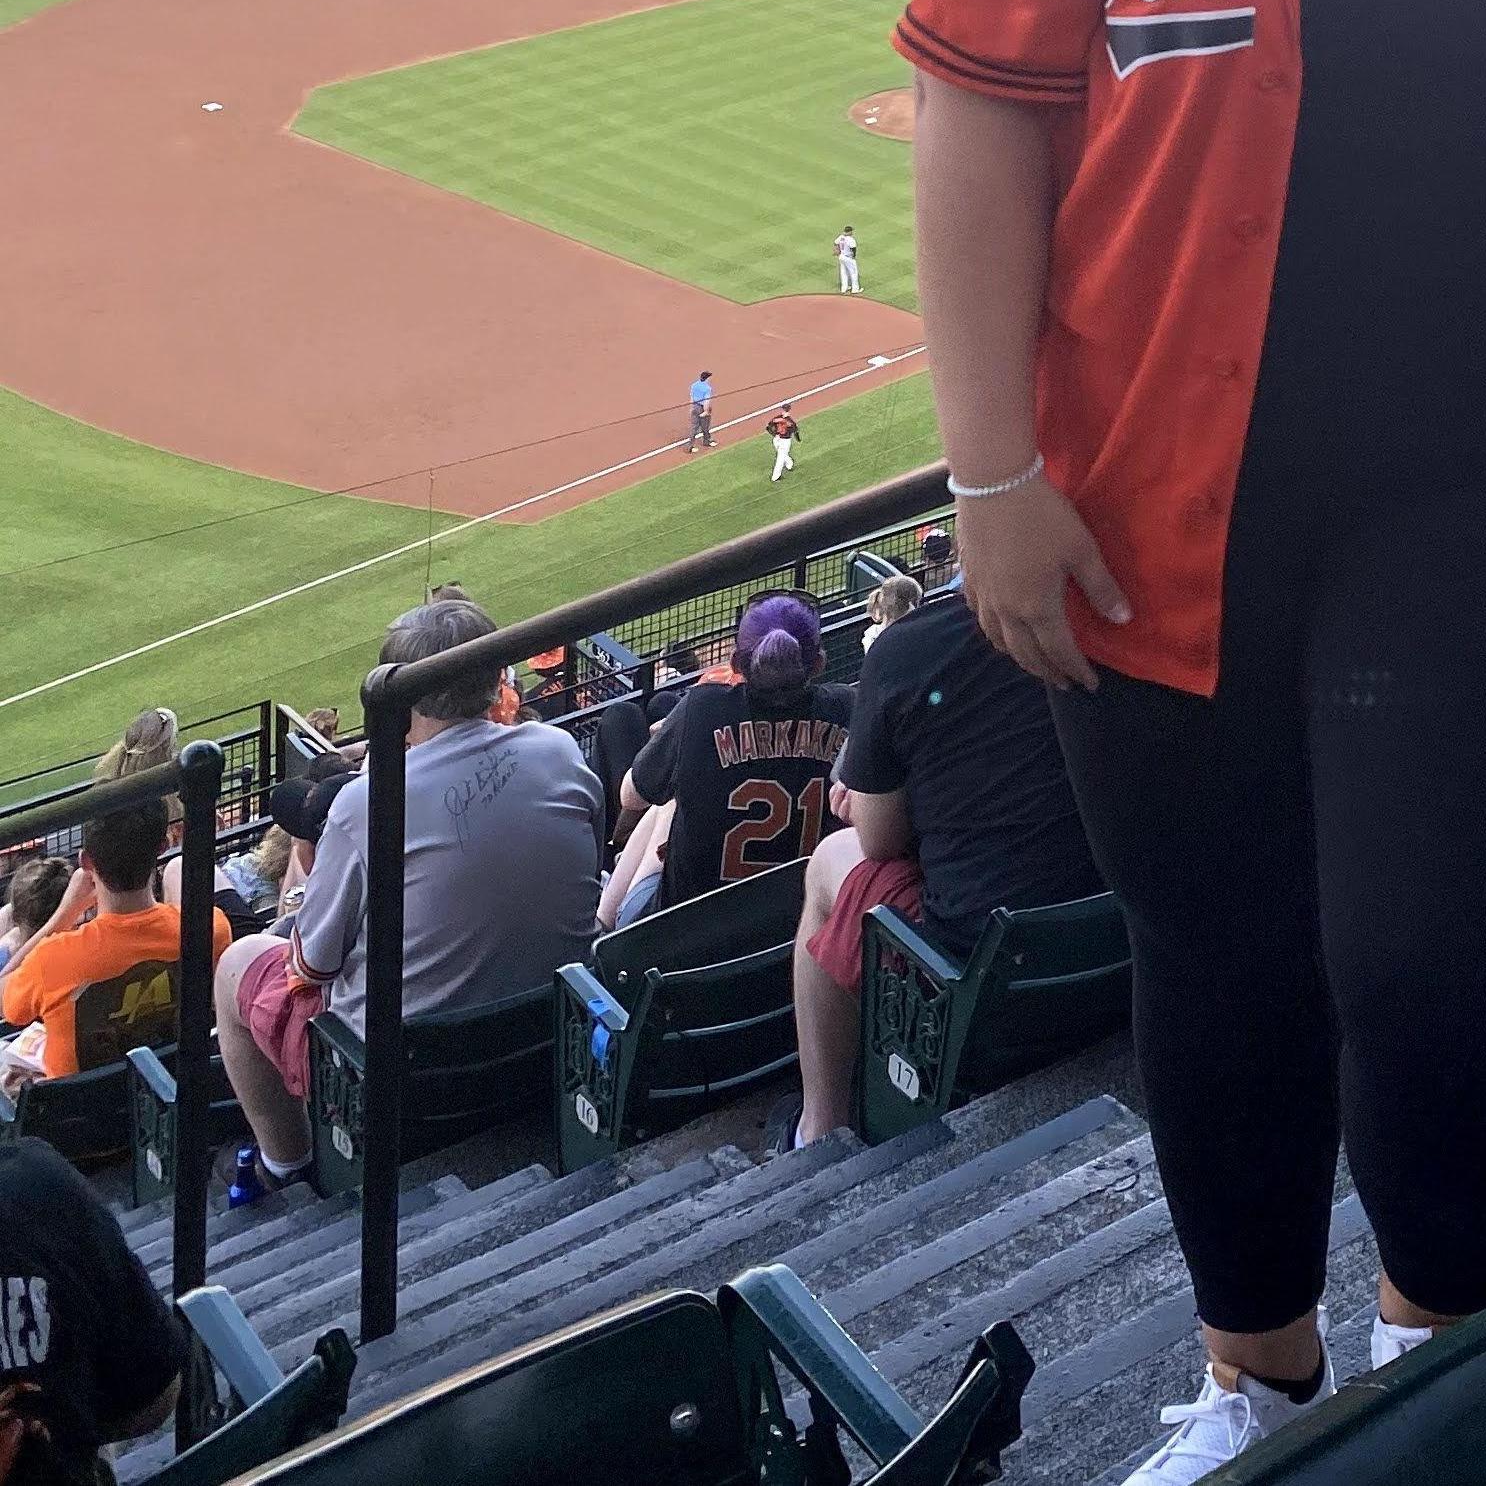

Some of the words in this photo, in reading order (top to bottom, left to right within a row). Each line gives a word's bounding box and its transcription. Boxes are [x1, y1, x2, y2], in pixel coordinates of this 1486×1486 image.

[713, 719, 849, 769] MARKAKE
[720, 777, 825, 882] 21
[896, 1061, 914, 1090] 17
[582, 1099, 594, 1127] 16
